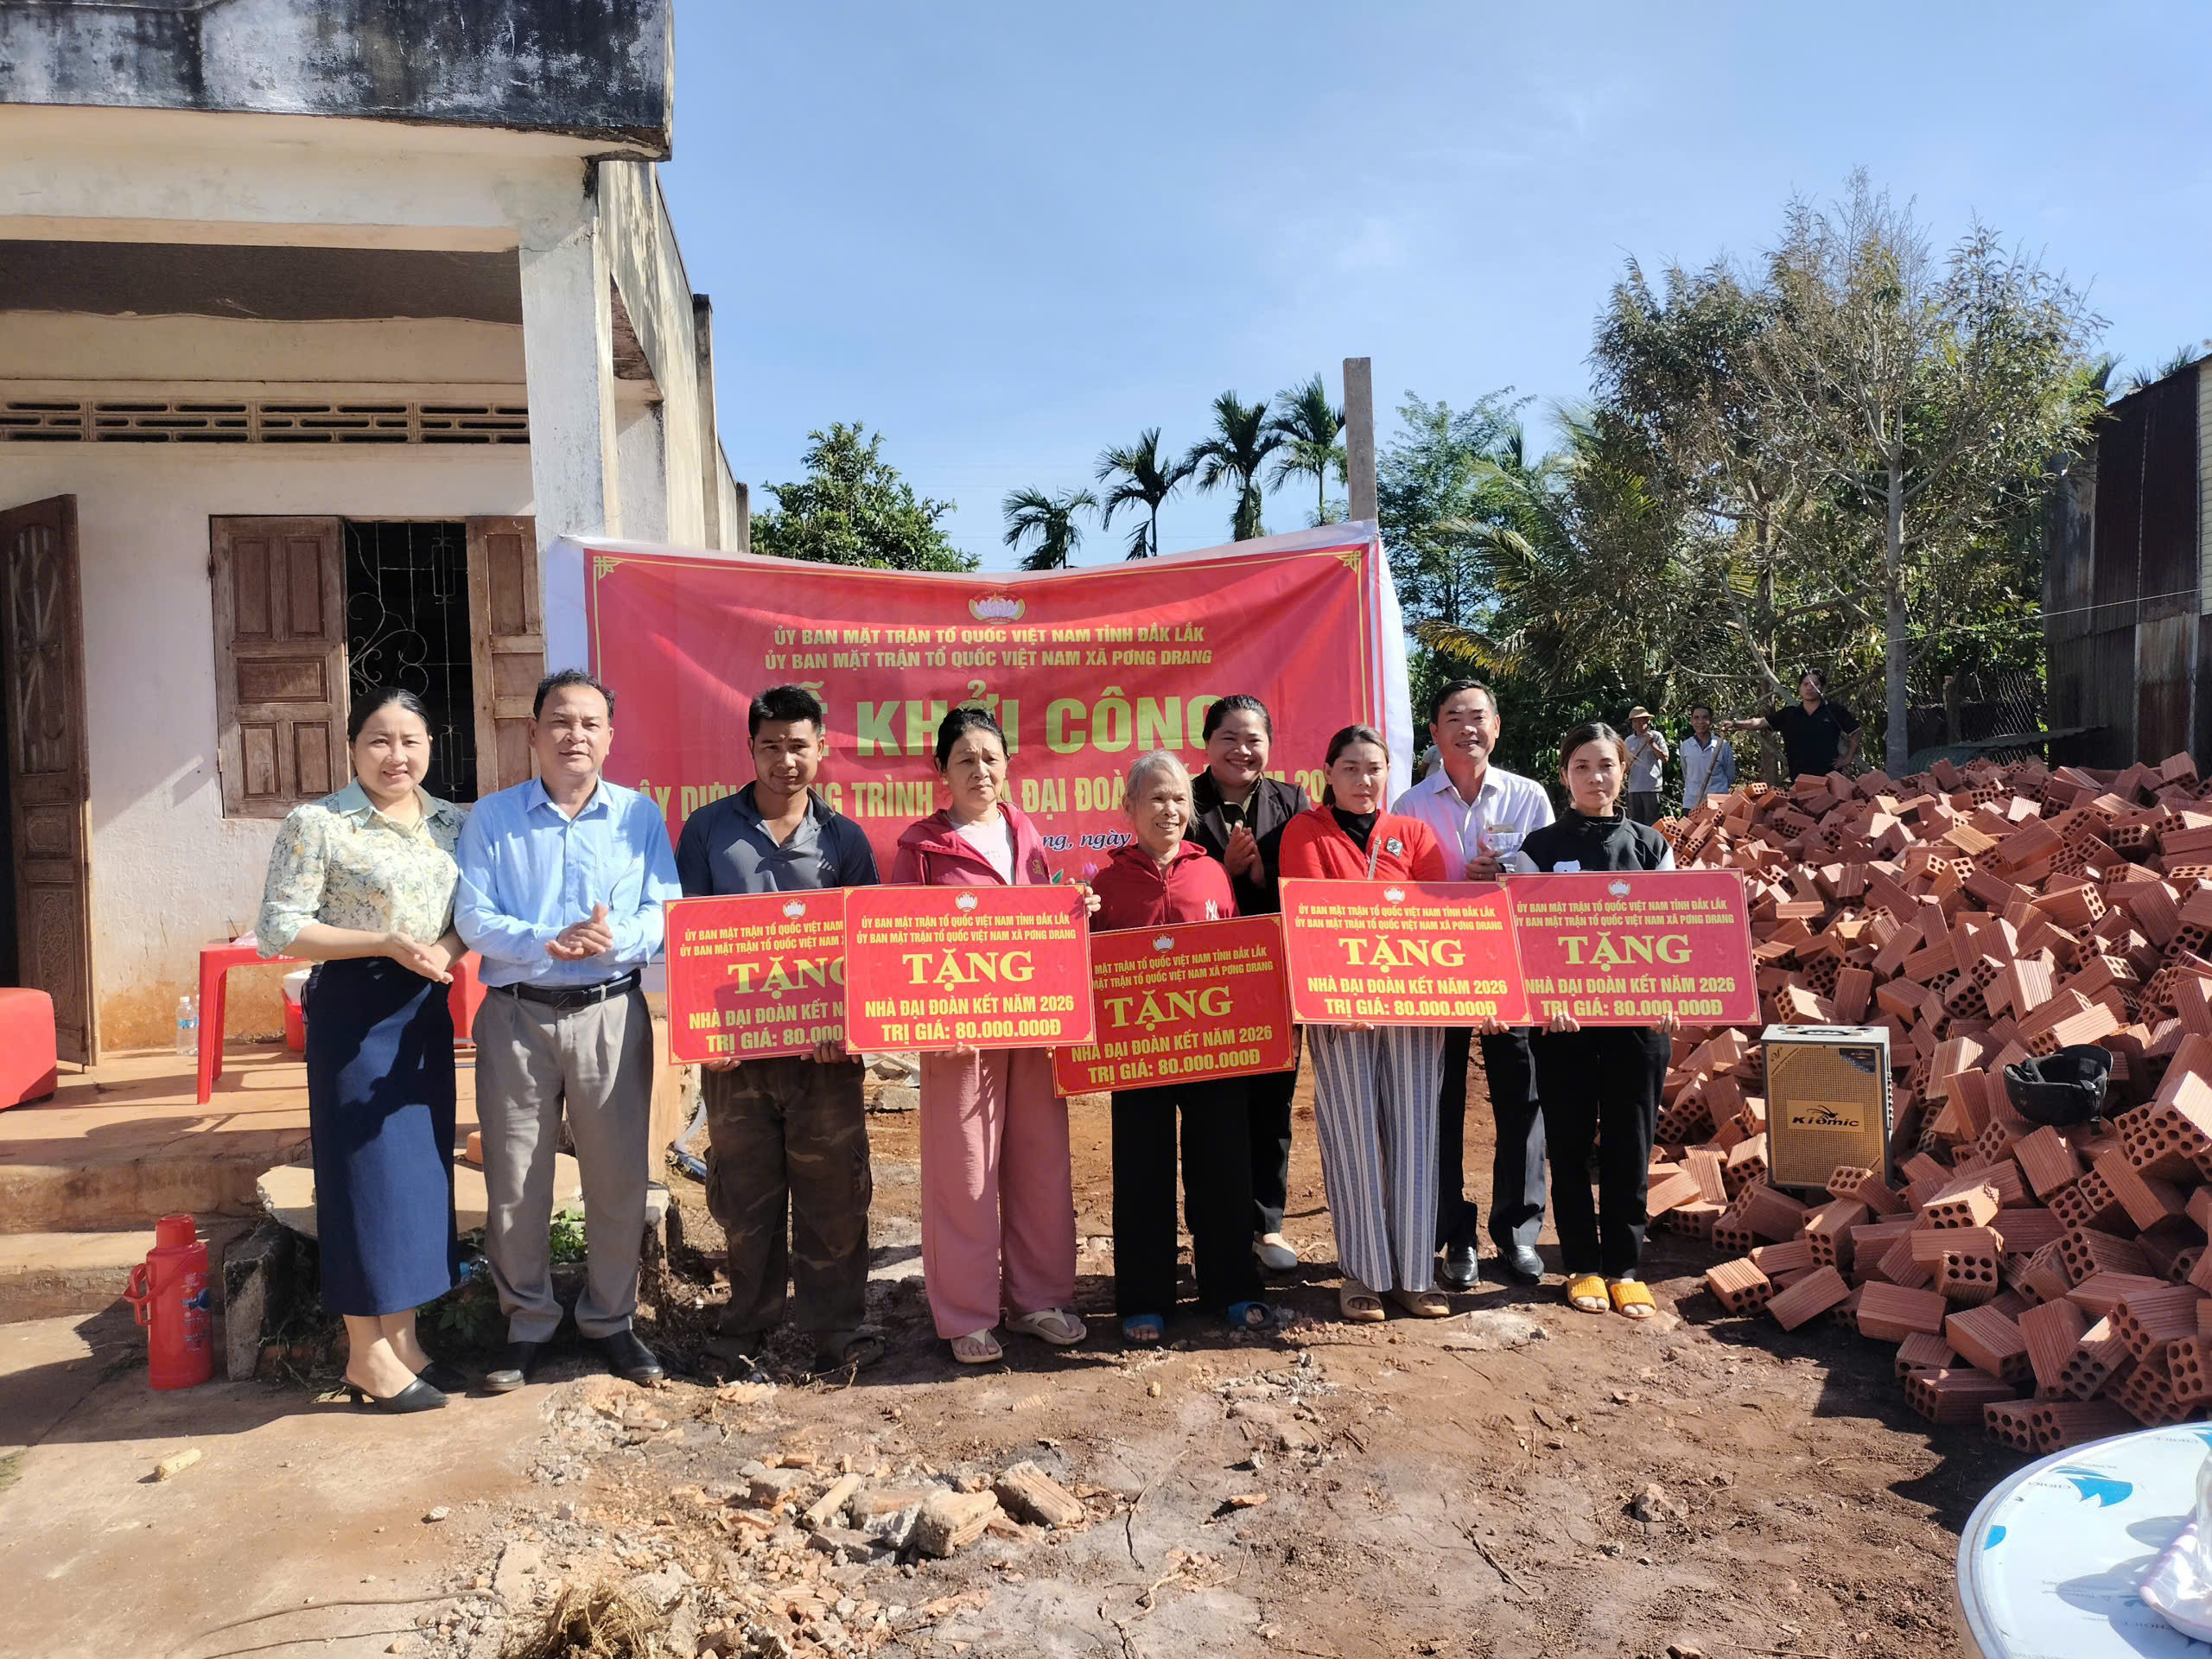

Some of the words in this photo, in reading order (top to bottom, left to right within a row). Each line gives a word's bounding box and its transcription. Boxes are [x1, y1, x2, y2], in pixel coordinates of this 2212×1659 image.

[774, 626, 796, 645] ỦY
[802, 630, 837, 645] BAN
[843, 628, 880, 646] MẶT
[886, 628, 930, 646] TRẬN
[962, 626, 1007, 644] QUỐC
[1012, 627, 1046, 646] VIỆT
[1052, 629, 1090, 642] NAM
[1095, 625, 1135, 642] TỈNH
[1138, 624, 1170, 642] ĐẮK
[1175, 623, 1204, 642] LẮK
[766, 651, 786, 670] ỦY
[791, 653, 828, 669] BAN
[833, 650, 870, 671] MẶT
[875, 649, 920, 671] TRẬN
[925, 645, 946, 667] TỔ
[951, 646, 996, 667] QUỐC
[1001, 649, 1037, 669] VIỆT
[1042, 651, 1080, 665] NAM
[1085, 649, 1108, 665] XÃ
[1112, 650, 1155, 665] PƠNG
[1160, 650, 1211, 665] DRANG
[852, 774, 933, 817] TRÌNH
[1021, 778, 1066, 821] ĐẠI
[1075, 769, 1125, 812] ĐOÀ
[1079, 830, 1132, 850] ngày
[1311, 906, 1327, 915] BAN
[1422, 908, 1440, 917] NAM
[1530, 903, 1548, 912] BAN
[1649, 901, 1669, 911] NAM
[699, 930, 717, 940] BAN
[804, 921, 821, 935] VIỆT
[823, 921, 843, 931] NAM
[875, 918, 892, 928] BAN
[976, 915, 992, 929] VIỆT
[995, 916, 1013, 926] NAM
[1306, 919, 1324, 928] BAN
[1420, 921, 1439, 930] NAM
[1476, 921, 1503, 931] DRANG
[1526, 917, 1543, 926] BAN
[1645, 915, 1665, 925] NAM
[1706, 914, 1734, 924] DRANG
[694, 945, 712, 956] BAN
[798, 936, 817, 950] VIỆT
[819, 936, 839, 946] NAM
[870, 933, 887, 944] BAN
[971, 929, 988, 944] VIỆT
[990, 931, 1009, 941] NAM
[1049, 929, 1077, 939] DRANG
[1173, 953, 1190, 968] VIỆT
[1192, 953, 1211, 964] NAM
[1338, 934, 1465, 973] TẶNG
[1558, 931, 1693, 972] TẶNG
[903, 948, 1035, 992] TẶNG
[1169, 969, 1186, 982] VIỆT
[1188, 968, 1207, 979] NAM
[1246, 961, 1274, 972] DRANG
[1307, 976, 1338, 993] NHÀ
[1339, 978, 1363, 995] ĐẠI
[1367, 976, 1406, 994] ĐOÀN
[1408, 976, 1433, 995] KẾT
[1437, 978, 1470, 995] NĂM
[1473, 980, 1508, 995] 2026
[1525, 976, 1555, 994] NHÀ
[1558, 978, 1582, 997] ĐẠI
[1586, 976, 1627, 994] ĐOÀN
[1630, 974, 1656, 994] KẾT
[1661, 975, 1695, 993] NĂM
[1700, 977, 1735, 992] 2026
[690, 1008, 721, 1029] NHÀ
[725, 1009, 751, 1028] ĐẠI
[755, 1003, 797, 1023] ĐOÀN
[802, 998, 828, 1020] KẾT
[865, 997, 896, 1017] NHÀ
[899, 1000, 925, 1020] ĐẠI
[929, 995, 969, 1015] ĐOÀN
[973, 992, 998, 1014] KẾT
[1002, 994, 1036, 1013] NĂM
[1040, 995, 1074, 1012] 2026
[1104, 986, 1234, 1032] TẶNG
[1325, 998, 1352, 1018] TRỊ
[1356, 997, 1390, 1015] GIÁ:
[1395, 1000, 1497, 1016] 80.000.000Đ
[1573, 997, 1609, 1017] GIÁ:
[706, 1033, 734, 1054] TRỊ
[741, 1027, 777, 1050] GIÁ:
[881, 1023, 909, 1045] TRỊ
[915, 1019, 950, 1040] GIÁ:
[955, 1019, 1061, 1039] 80.000.000Đ
[1104, 1041, 1128, 1060] ĐẠI
[1132, 1035, 1170, 1054] ĐOÀN
[1174, 1029, 1199, 1051] KẾT
[1203, 1027, 1235, 1047] NĂM
[1239, 1026, 1272, 1043] 2026
[1088, 1065, 1115, 1084] TRỊ
[1120, 1058, 1154, 1080] GIÁ:
[1159, 1049, 1260, 1076] 80.000.000Đ
